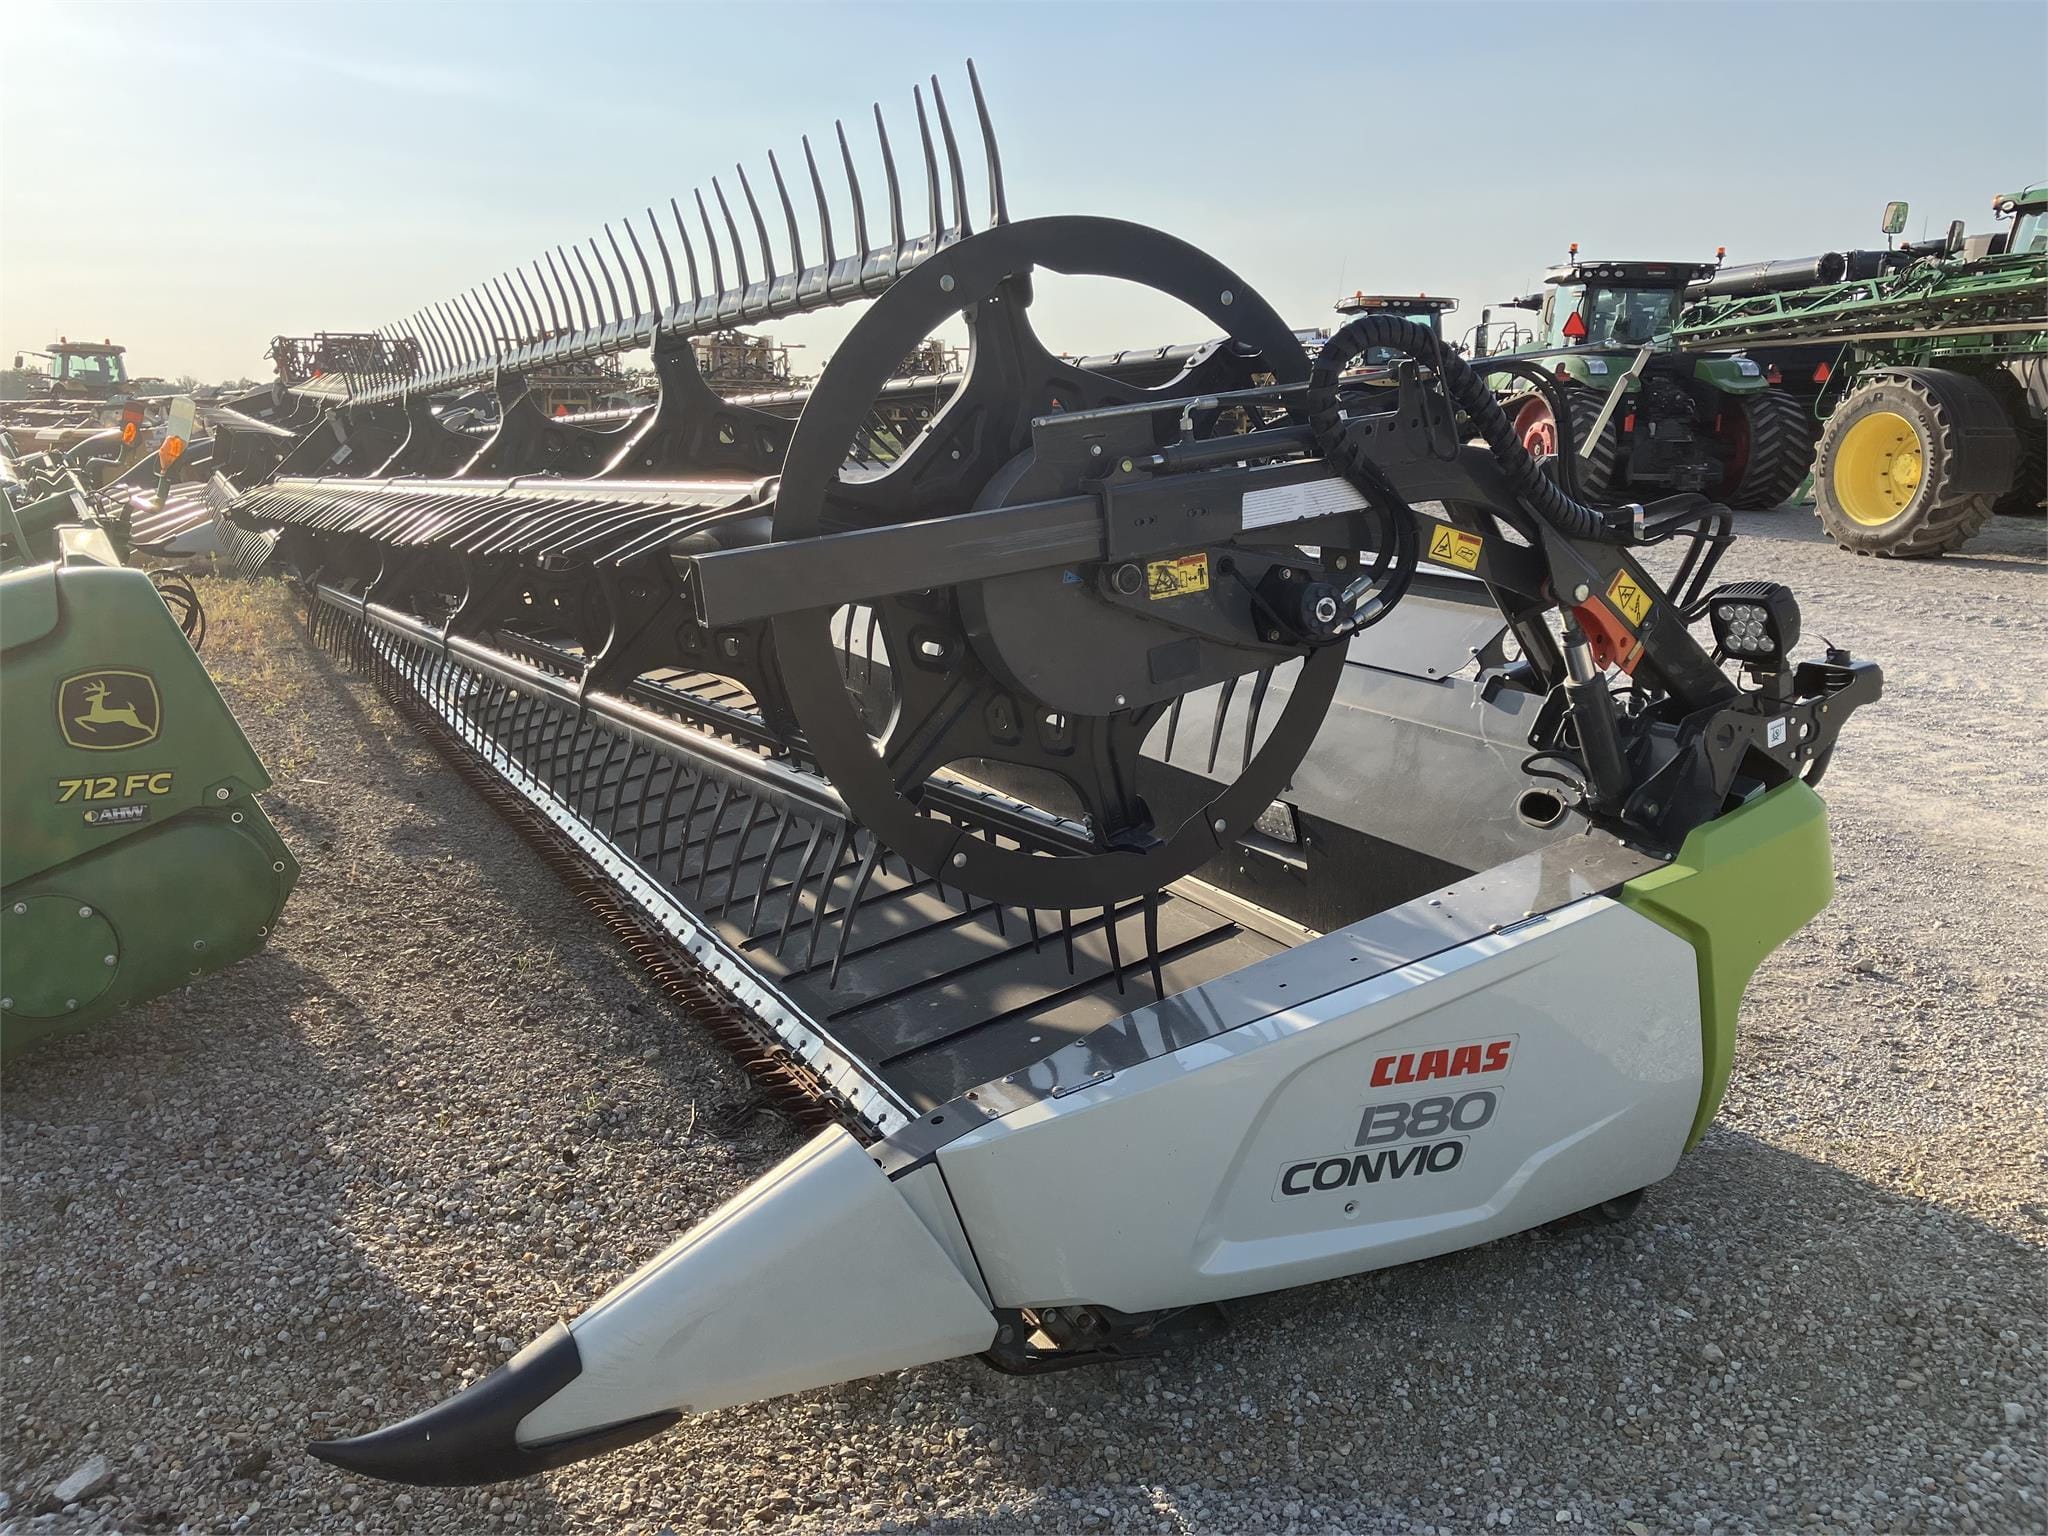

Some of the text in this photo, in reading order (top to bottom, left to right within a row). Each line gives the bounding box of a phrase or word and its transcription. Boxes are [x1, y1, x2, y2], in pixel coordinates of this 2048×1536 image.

[57, 772, 172, 802] 712 FC
[100, 805, 144, 822] AHW
[1369, 1041, 1511, 1088] CLAAS
[1354, 1091, 1497, 1147] B80
[1281, 1140, 1463, 1196] CONVIO
